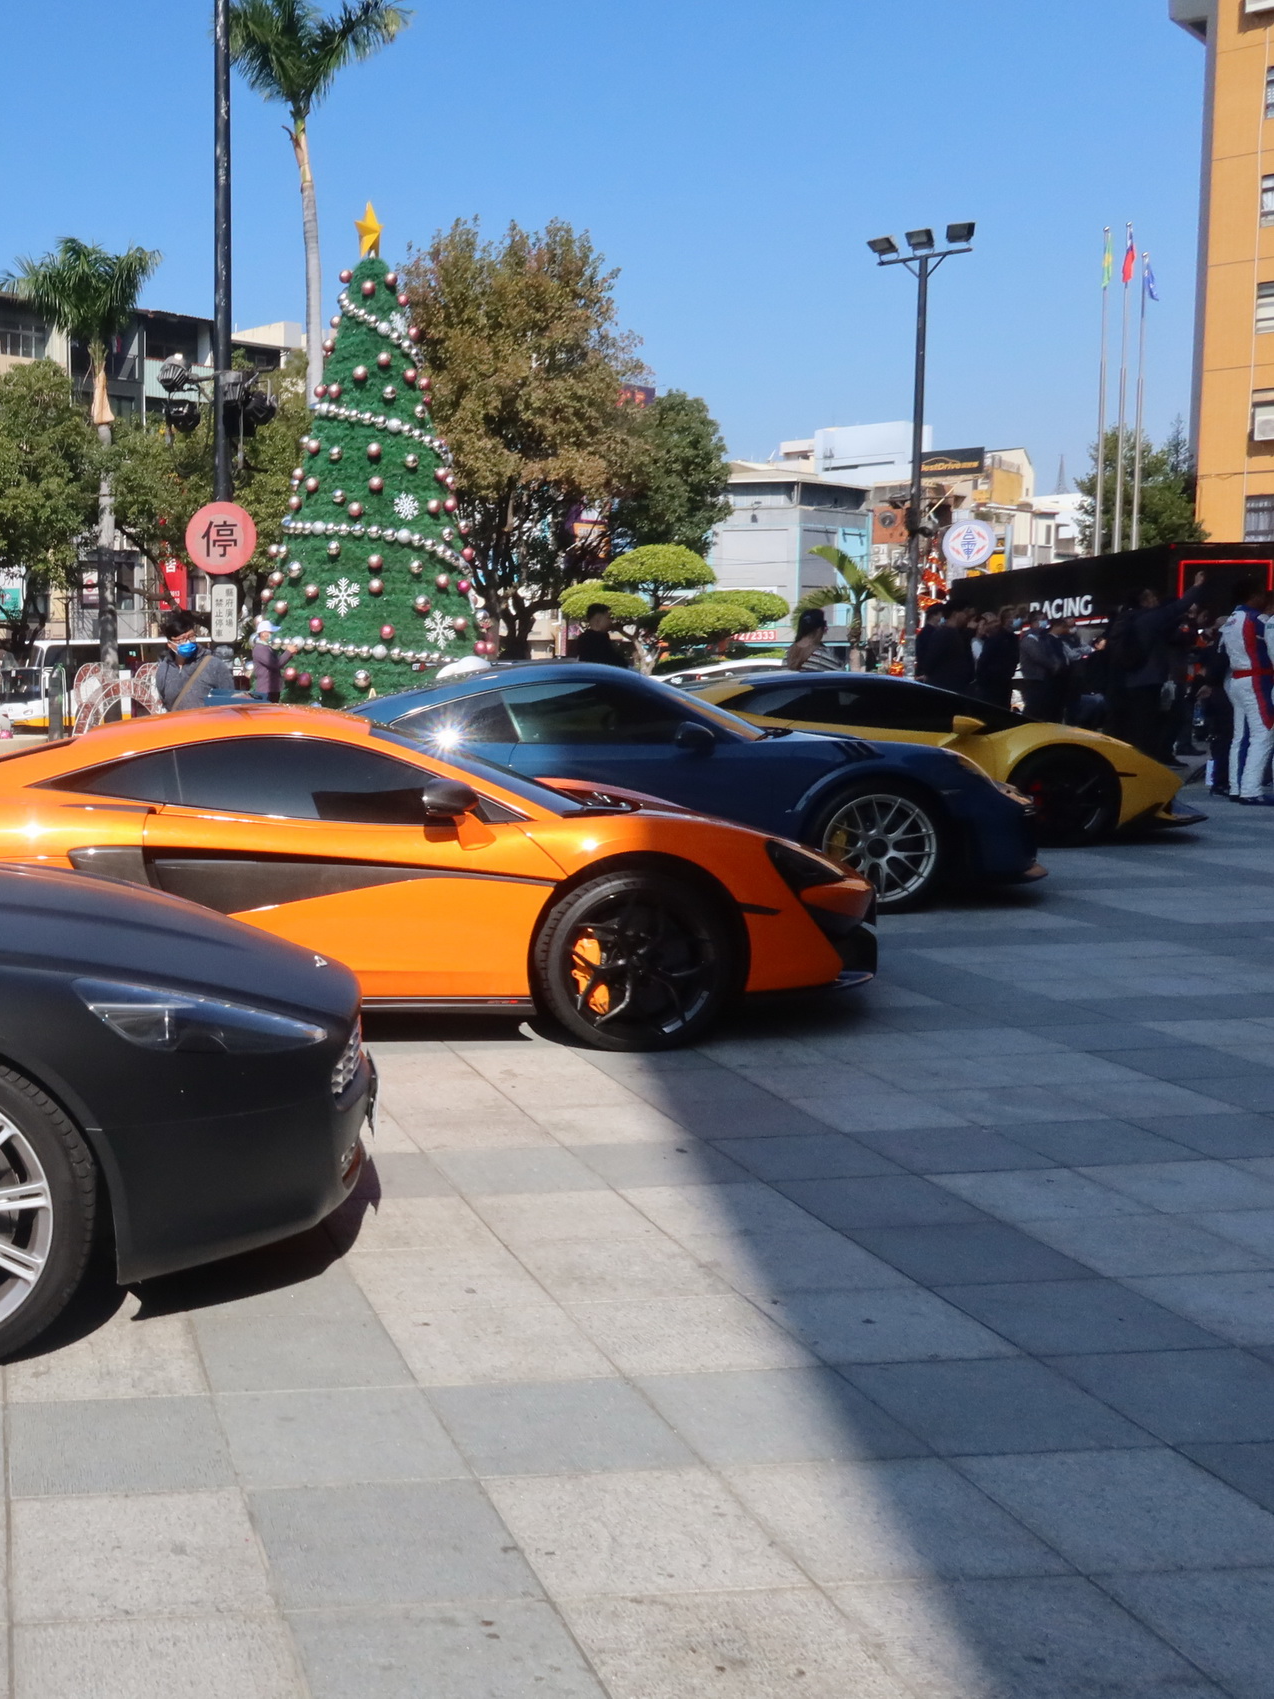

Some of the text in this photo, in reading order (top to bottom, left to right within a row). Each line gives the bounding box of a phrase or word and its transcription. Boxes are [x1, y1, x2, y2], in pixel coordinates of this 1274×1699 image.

[201, 520, 237, 557] 停
[215, 598, 224, 638] 禁止停車
[1030, 594, 1093, 620] RACING
